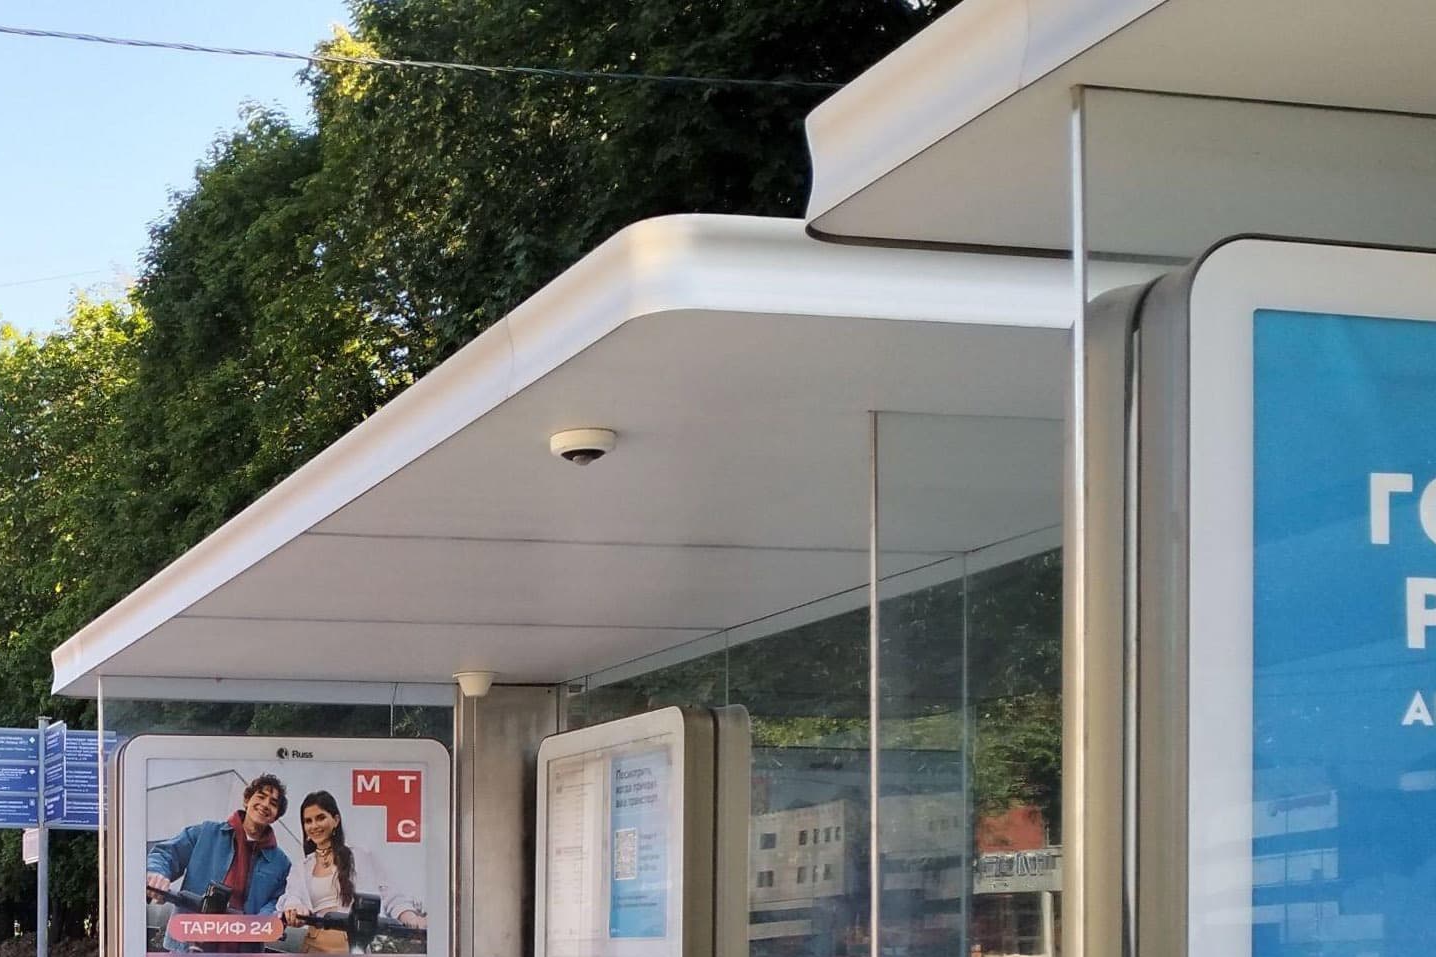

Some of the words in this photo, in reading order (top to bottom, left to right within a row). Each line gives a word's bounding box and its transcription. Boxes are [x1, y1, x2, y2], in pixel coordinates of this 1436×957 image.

[1370, 472, 1436, 544] Г
[292, 750, 314, 759] Russ
[180, 921, 246, 936] ТАРИФ
[250, 921, 273, 936] 24
